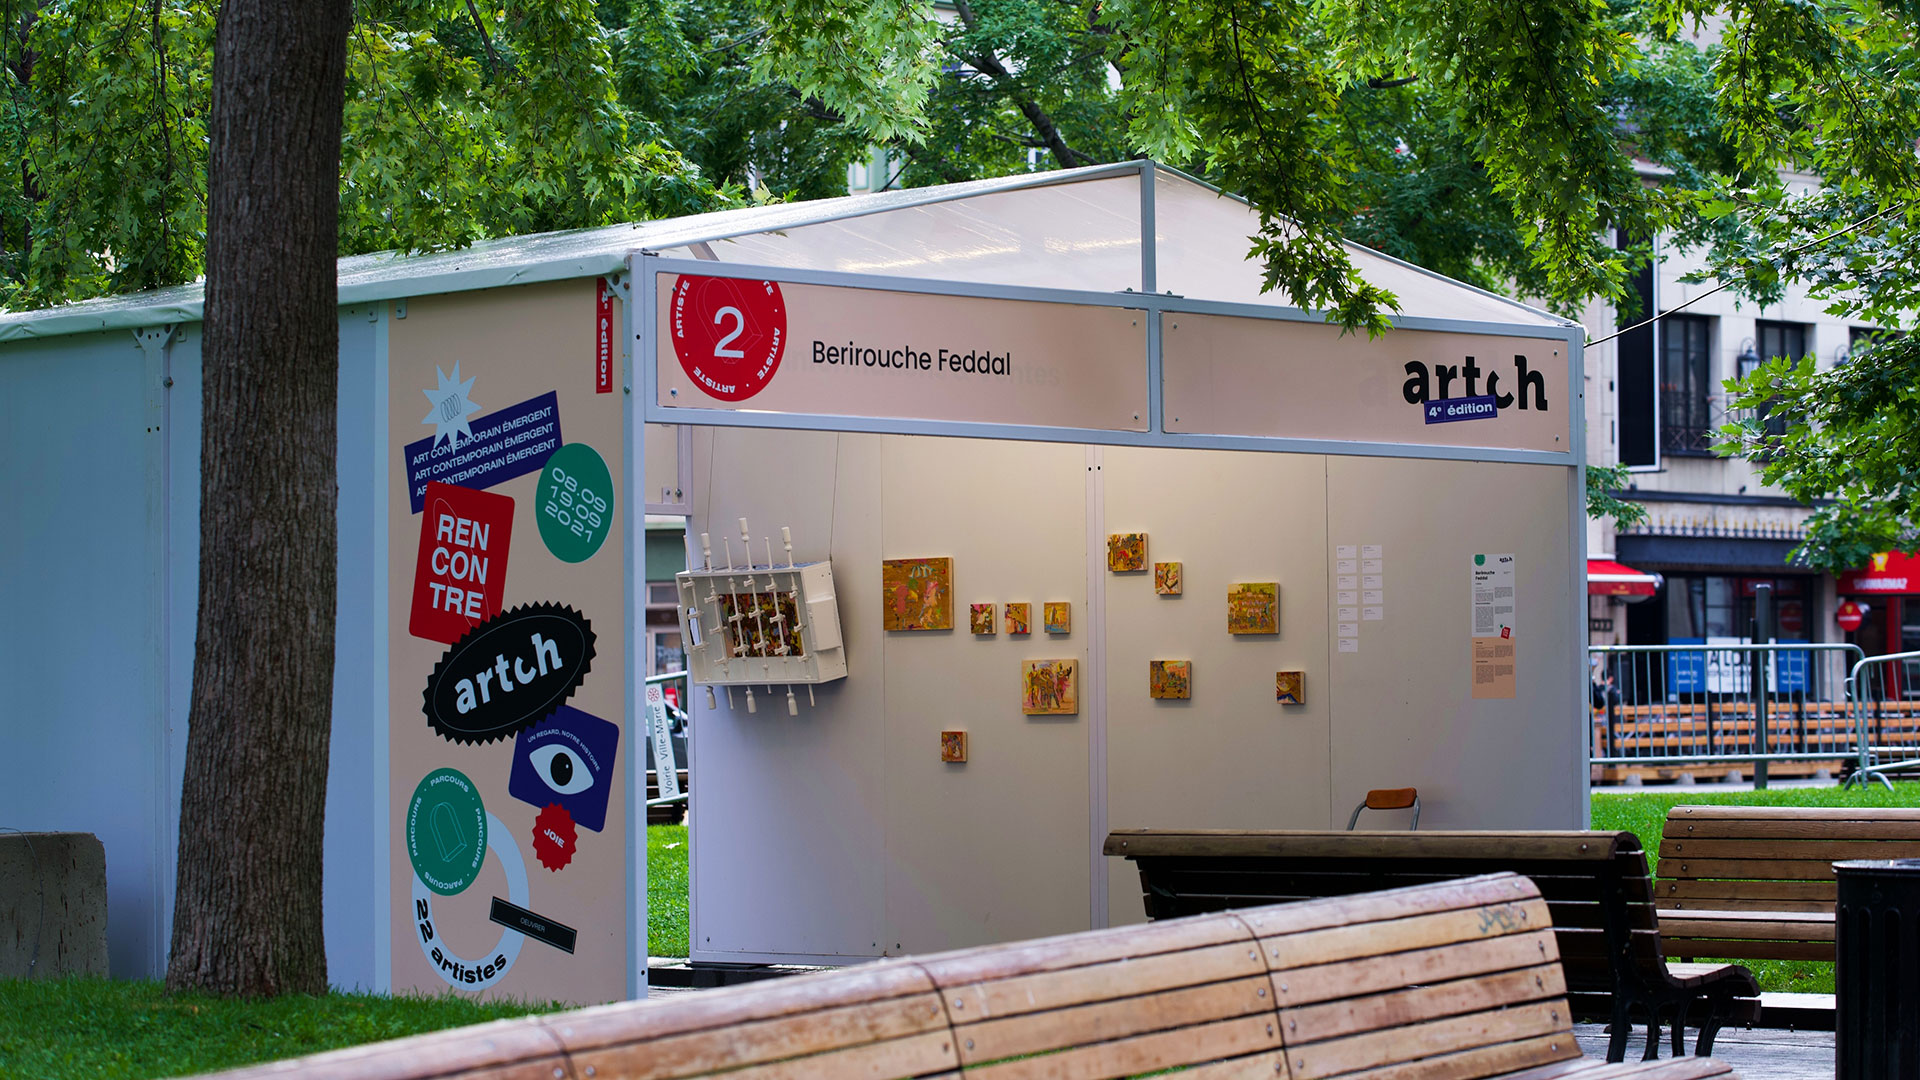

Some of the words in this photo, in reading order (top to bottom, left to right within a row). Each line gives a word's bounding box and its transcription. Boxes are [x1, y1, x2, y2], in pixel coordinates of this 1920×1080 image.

[676, 280, 690, 338] ARTISTE
[714, 306, 745, 358] 2
[757, 328, 780, 380] ARTISTE
[693, 367, 736, 394] ARTISTE
[812, 341, 932, 370] Berirouche
[938, 349, 1011, 376] Feddal
[1403, 355, 1548, 412] artch
[1447, 402, 1493, 416] édition
[413, 451, 429, 466] ART
[503, 407, 552, 432] ÉMERGENT
[414, 467, 431, 481] ART
[432, 441, 503, 475] CONTEMPORAIN
[504, 423, 554, 448] ÉMERGENT
[416, 484, 428, 497] AR
[507, 439, 556, 464] ÉMERGENT
[552, 467, 606, 513] 08.09
[545, 500, 593, 543] 2021
[551, 485, 601, 528] 19.09
[437, 514, 490, 551] REN
[431, 546, 489, 584] CON
[429, 582, 484, 619] TRE
[454, 632, 563, 715] artch
[527, 734, 536, 743] UN
[536, 728, 561, 740] REGARD,
[561, 729, 580, 745] NOTRE
[580, 742, 600, 772] HISTOIRE
[655, 706, 669, 761] Ville-Marie
[430, 775, 469, 793] PARCOURS
[664, 765, 673, 794] Voirie
[410, 796, 422, 857] PARCOURS
[471, 807, 484, 868] PARCOURS
[543, 828, 565, 848] JOIE
[424, 871, 463, 890] PARCOURS
[416, 898, 434, 943] 22
[431, 947, 507, 984] artistes
